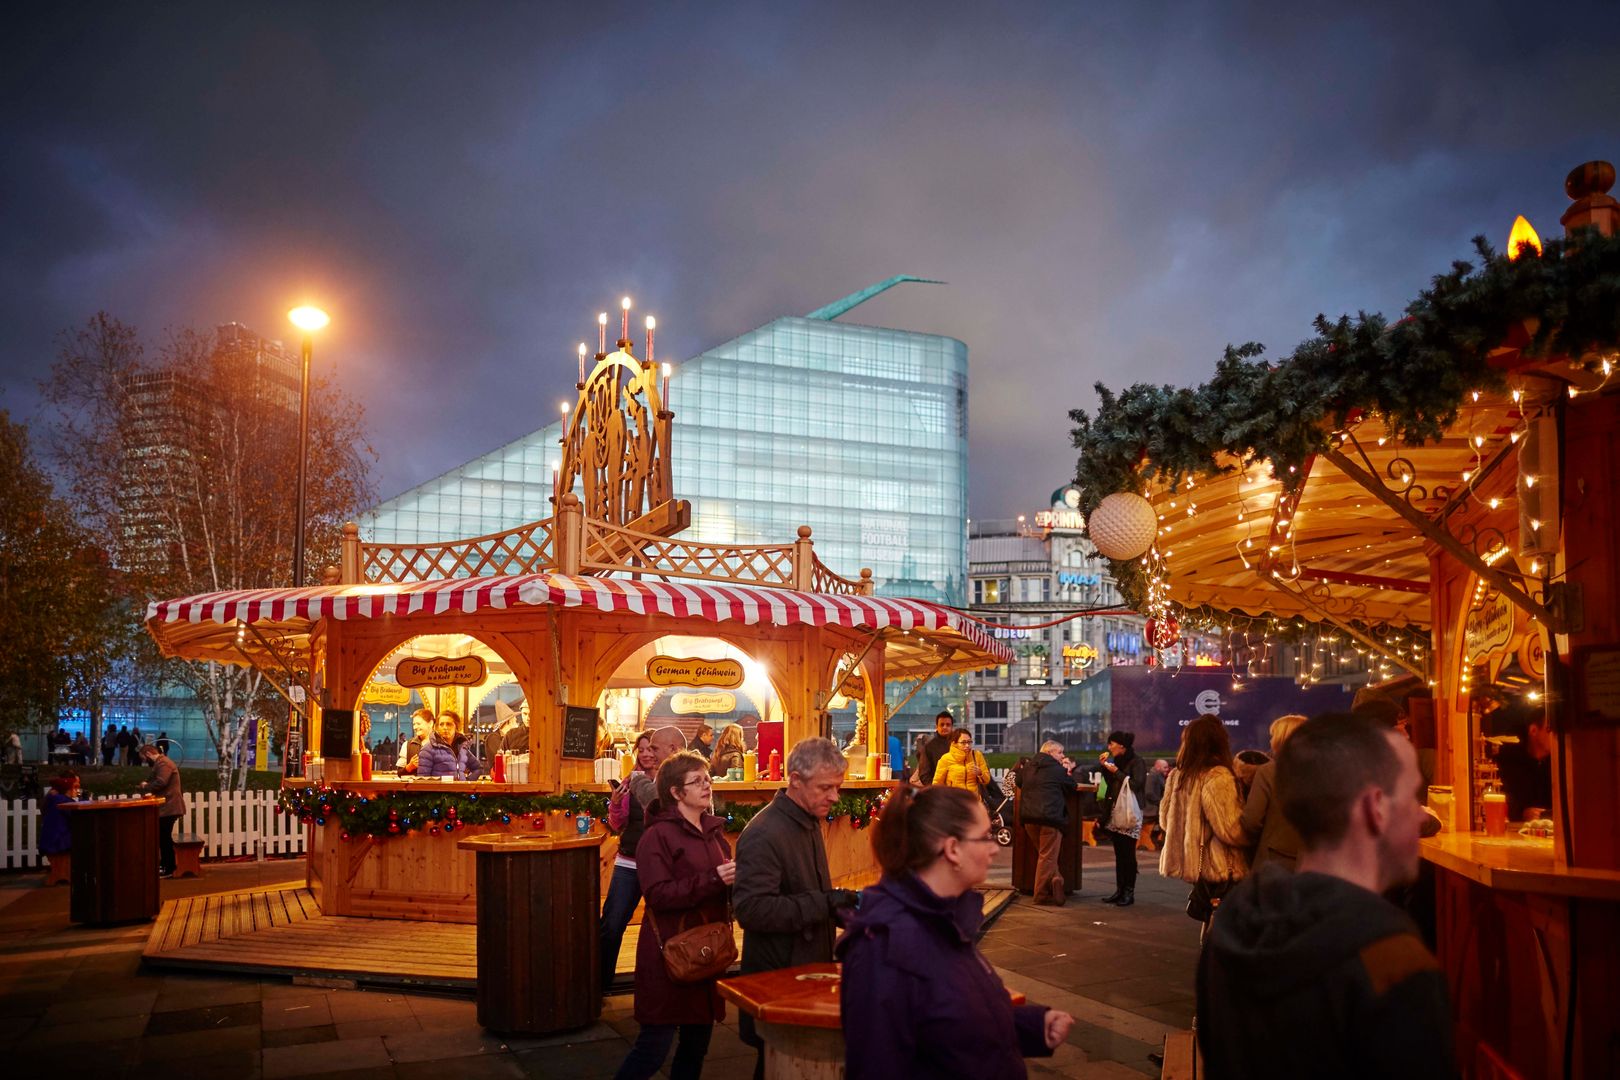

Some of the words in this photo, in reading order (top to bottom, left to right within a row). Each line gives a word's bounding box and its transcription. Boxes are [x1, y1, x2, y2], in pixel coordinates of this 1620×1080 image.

[861, 532, 907, 546] FOOTBALL
[1059, 572, 1099, 585] IMAX
[412, 665, 426, 676] Big
[656, 665, 690, 676] German
[695, 667, 736, 677] Glühwein
